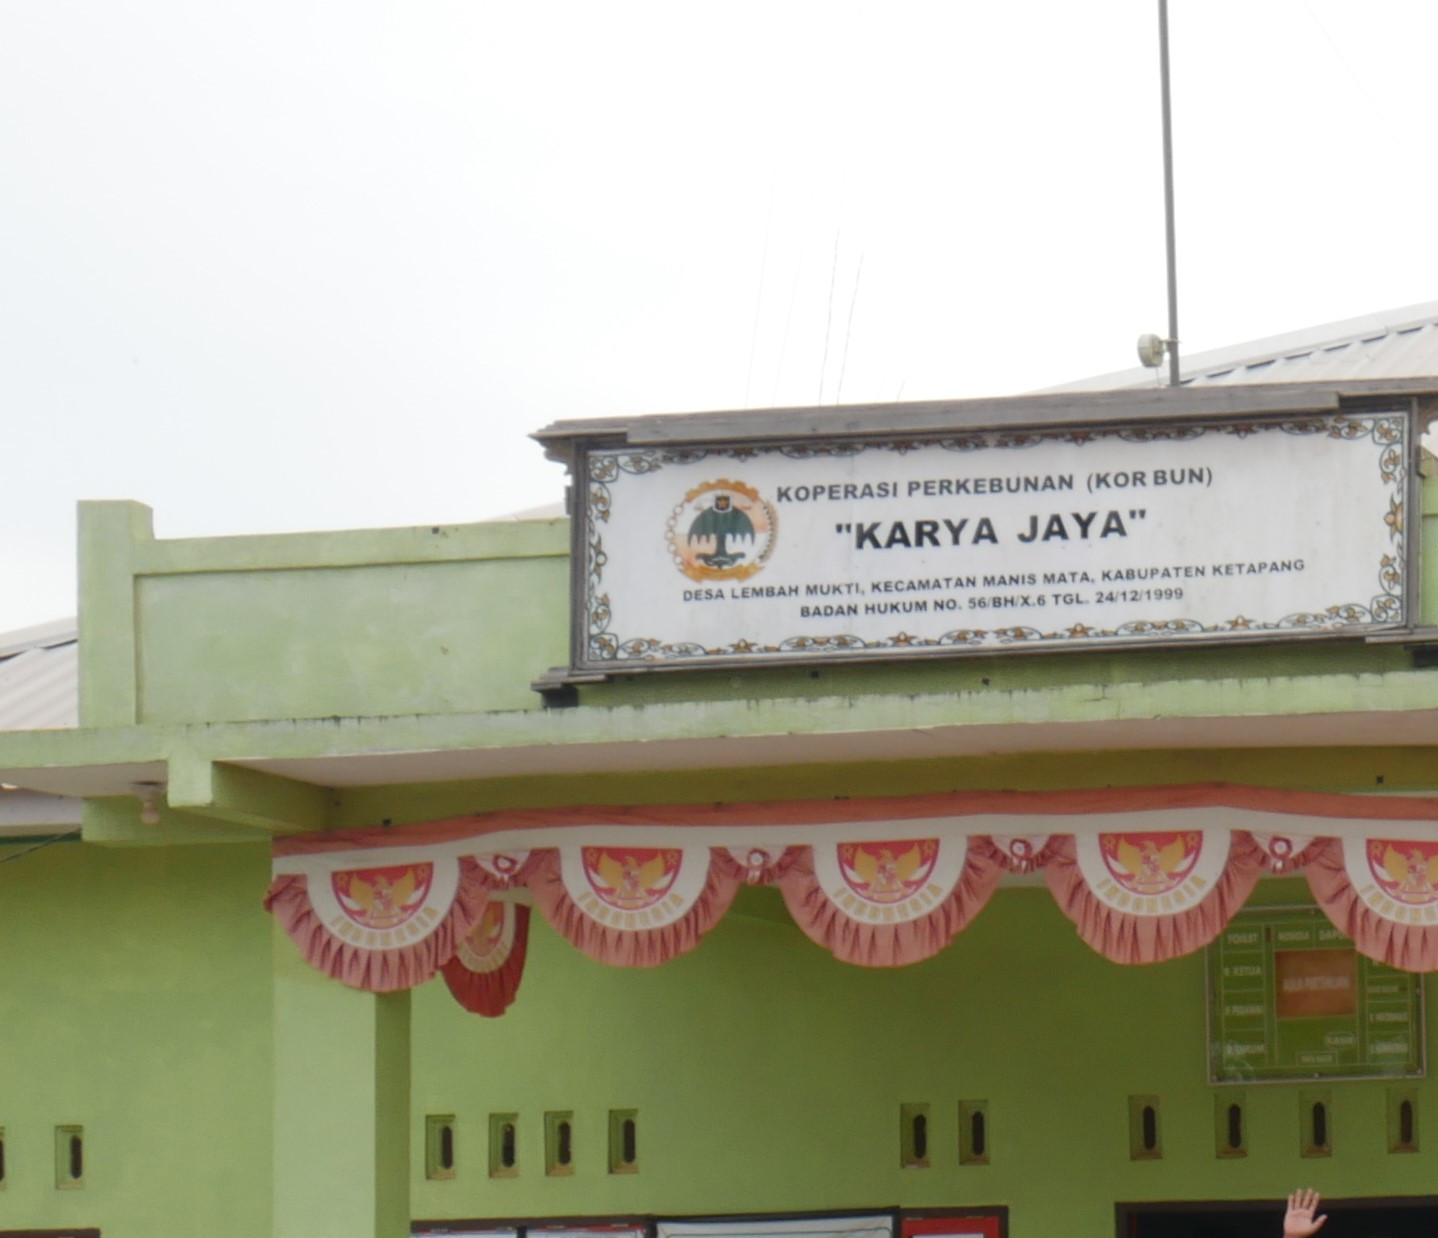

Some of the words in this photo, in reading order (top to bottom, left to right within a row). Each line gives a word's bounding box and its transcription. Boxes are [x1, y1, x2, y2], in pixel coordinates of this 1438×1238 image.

[777, 482, 898, 502] KOPERASI
[907, 474, 1074, 497] PERKEBUNAN
[835, 517, 998, 550] "KARYA
[1017, 508, 1147, 543] JAYA"
[683, 588, 725, 602] DESA
[731, 585, 799, 599] LEMBAH
[805, 582, 865, 596] MUKTI,
[871, 576, 977, 593] KECAMATAN
[982, 573, 1037, 587] MANIS
[1043, 570, 1095, 585] MATA,
[1101, 565, 1206, 582] KABUPATEN
[1212, 559, 1305, 576] KETAPANG
[800, 604, 858, 617] BADAN
[864, 600, 927, 615] HUKUM
[933, 599, 962, 611] NO.
[1052, 592, 1090, 606] TGL.
[1095, 588, 1184, 604] 24/12/1999
